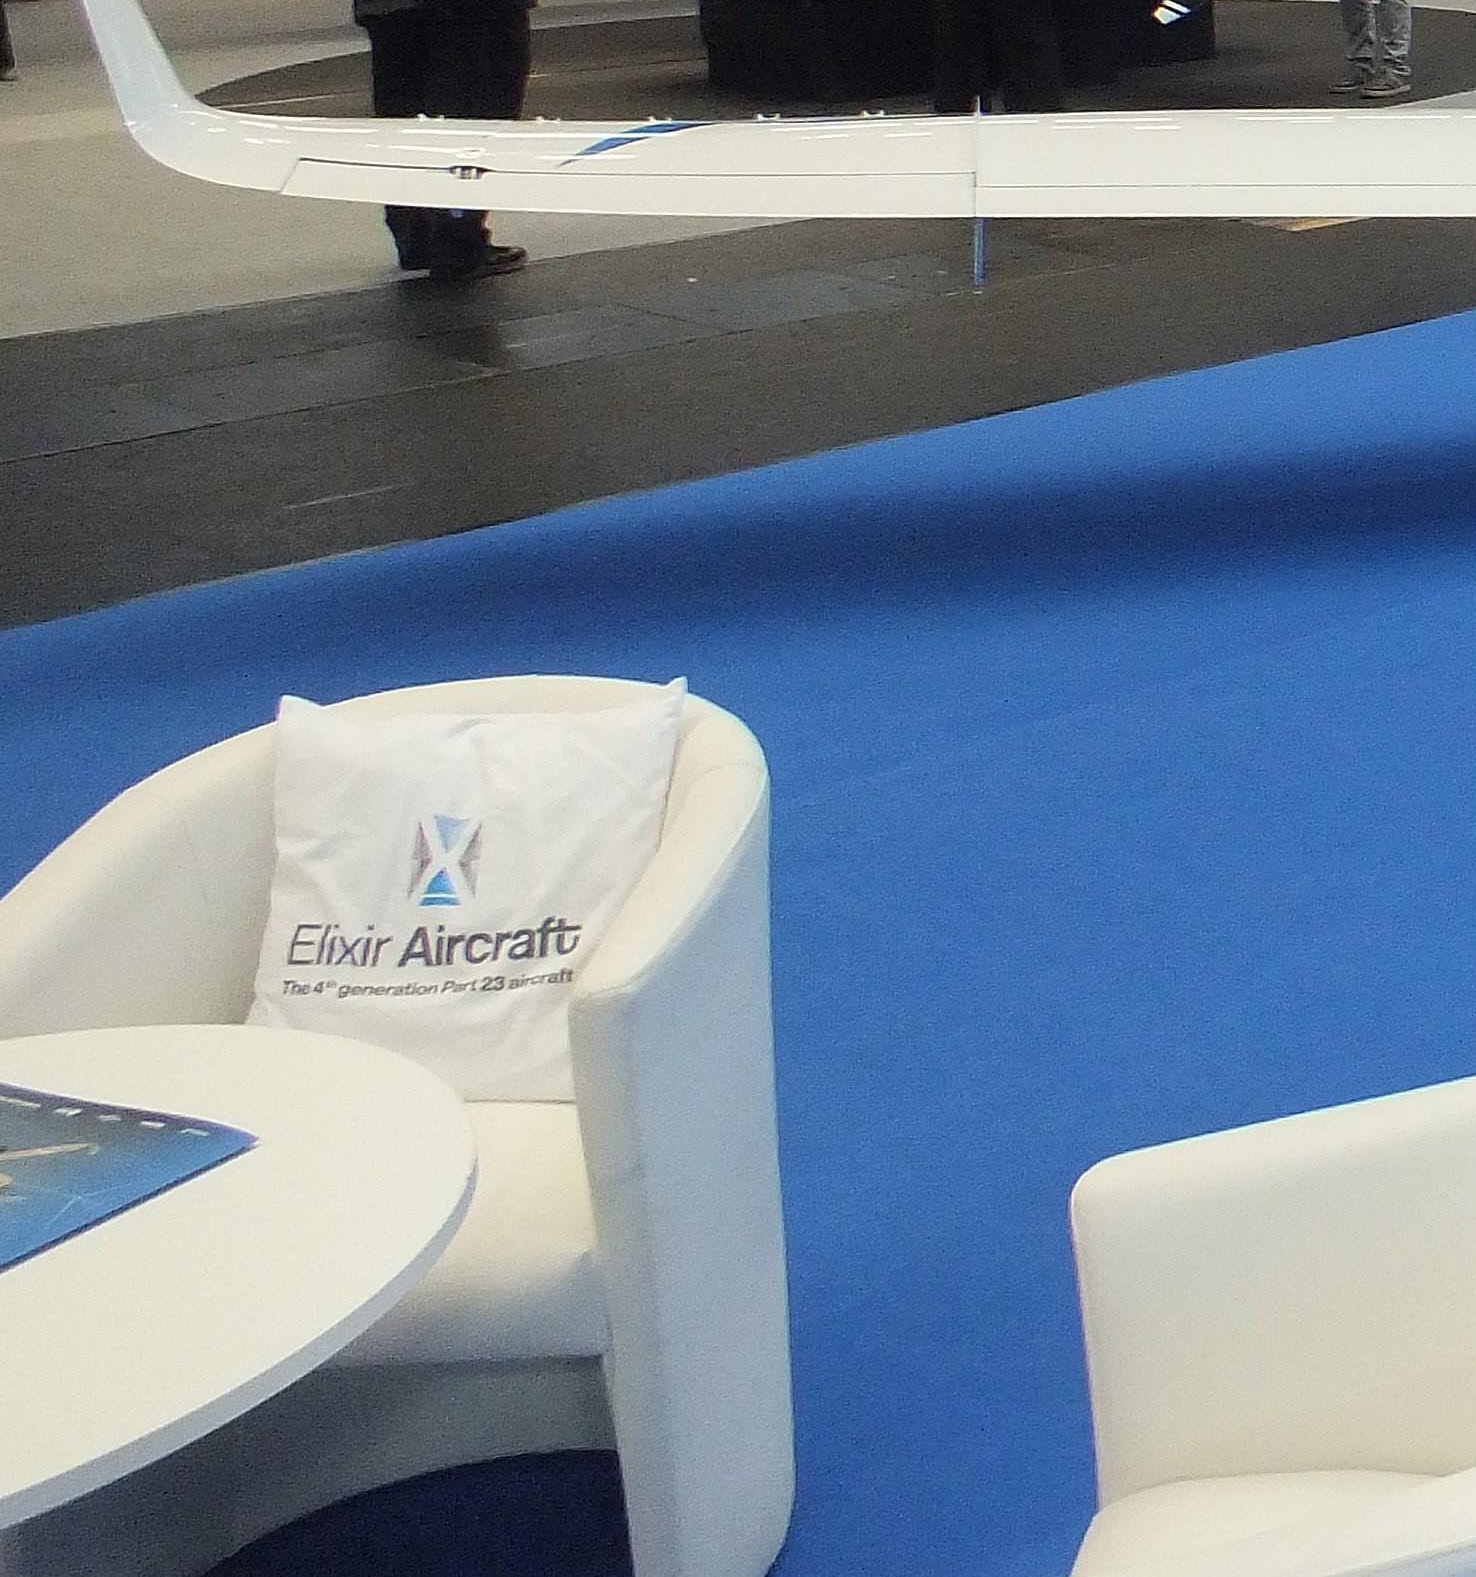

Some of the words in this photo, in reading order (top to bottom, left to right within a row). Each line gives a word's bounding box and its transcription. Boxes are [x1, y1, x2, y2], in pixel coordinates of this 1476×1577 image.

[287, 923, 393, 967] Elixir
[397, 916, 583, 968] Aircraft
[282, 979, 311, 997] The
[338, 982, 438, 999] generation
[439, 979, 478, 996] Part
[479, 978, 507, 994] 23
[508, 969, 574, 991] aircraft
